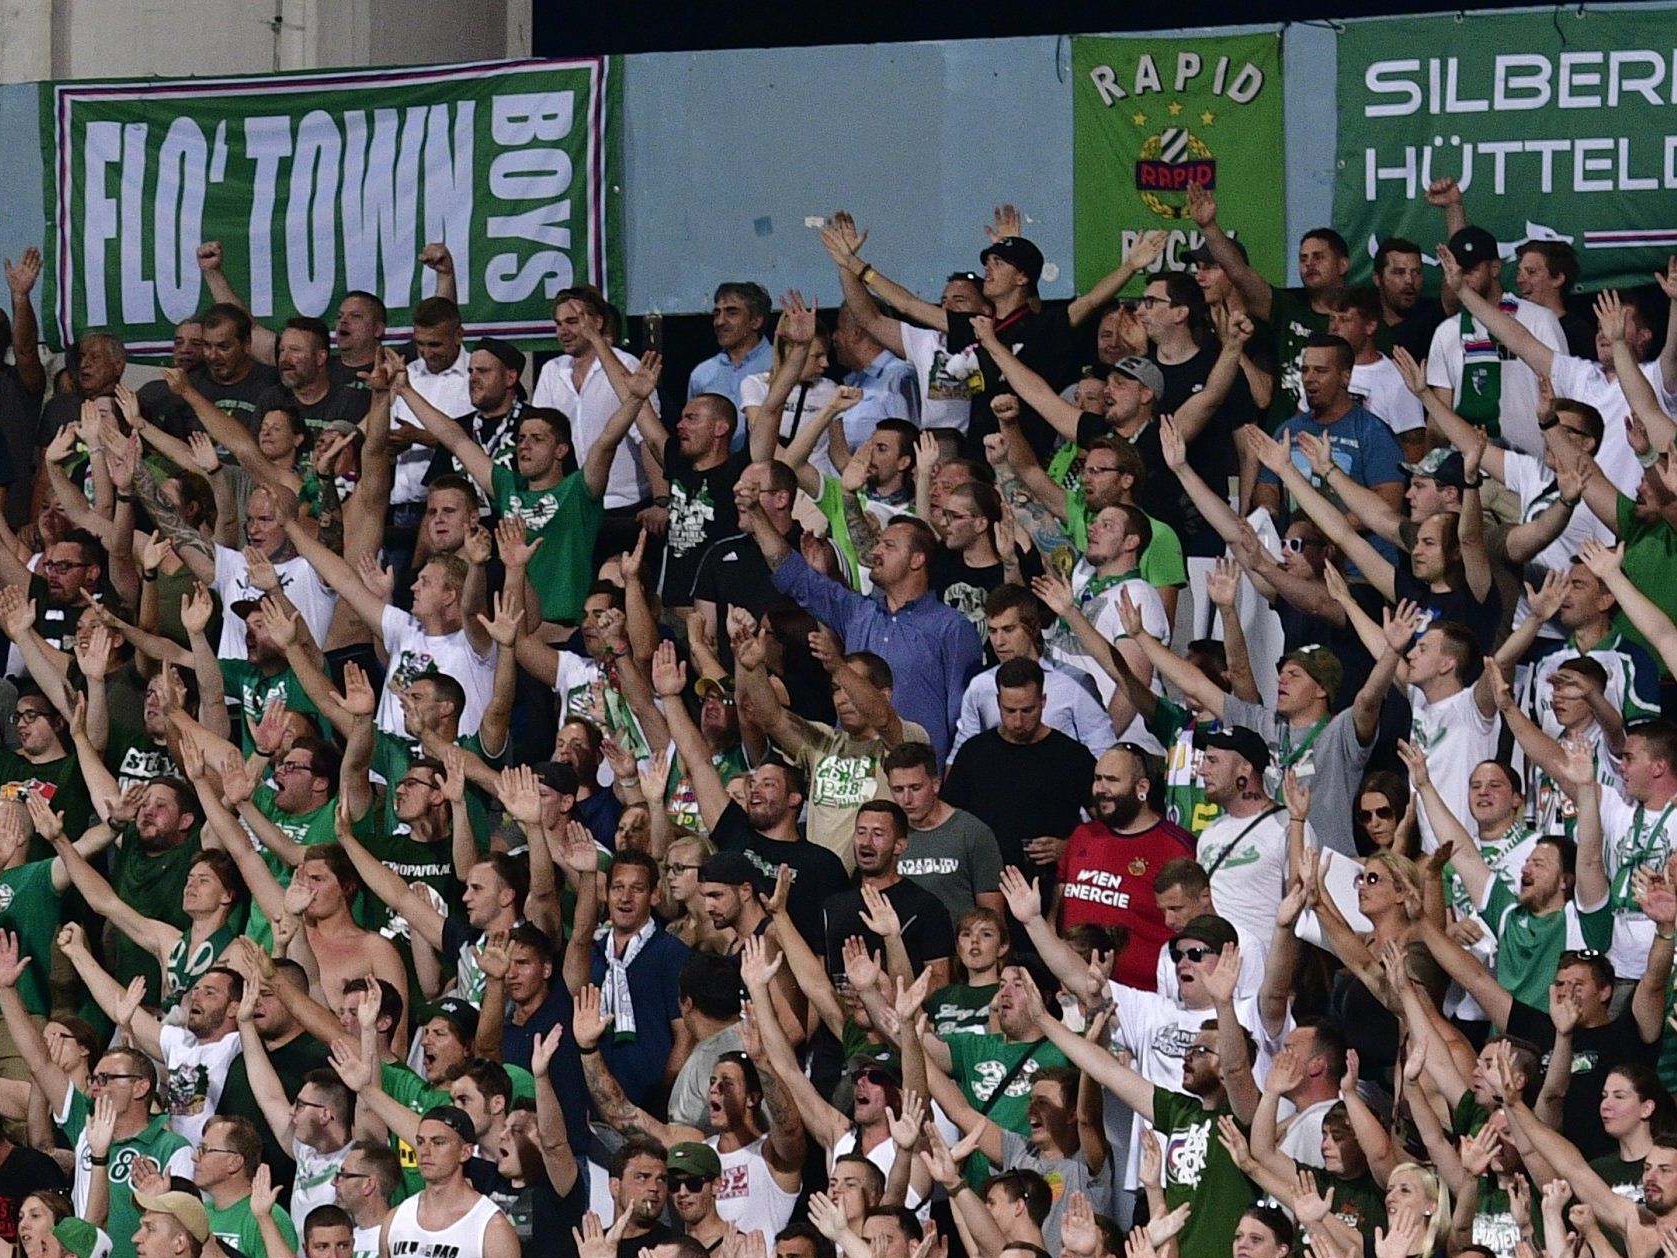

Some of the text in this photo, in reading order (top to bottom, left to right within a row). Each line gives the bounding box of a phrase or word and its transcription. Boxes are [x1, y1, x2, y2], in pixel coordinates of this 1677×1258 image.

[1090, 52, 1264, 107] RAPID
[1364, 48, 1677, 118] SILBER
[485, 90, 575, 302] BOYS
[1140, 164, 1214, 188] RAPID
[1064, 885, 1131, 910] ENERGIE
[1076, 869, 1124, 889] WIEN
